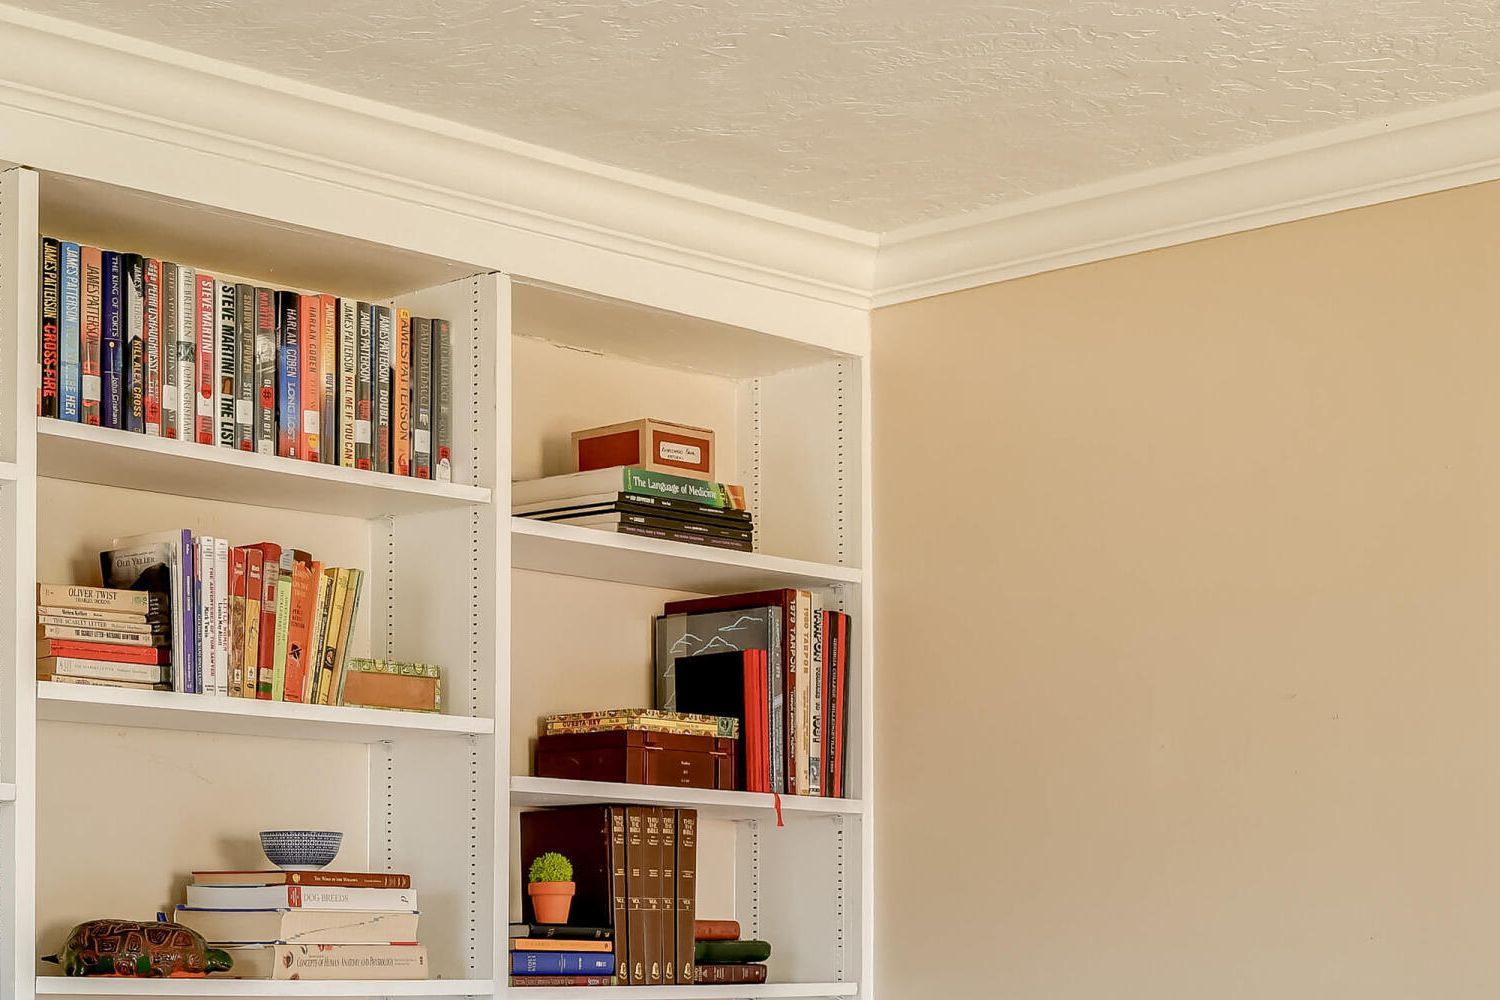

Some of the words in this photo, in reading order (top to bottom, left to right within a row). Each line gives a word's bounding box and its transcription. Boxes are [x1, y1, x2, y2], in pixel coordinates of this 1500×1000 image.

[44, 242, 58, 271] JAMES
[67, 247, 79, 275] JAMES
[86, 264, 100, 294] JAMES
[134, 264, 143, 288] JAMES
[43, 270, 58, 318] PATTERSON
[65, 276, 78, 323] PATTERSON
[112, 297, 119, 311] OF
[201, 281, 212, 311] STEVE
[222, 286, 235, 316] STEVE
[86, 294, 100, 347] PATTERSON
[286, 308, 297, 345] HARLAN
[309, 306, 317, 341] HARLAN
[344, 303, 353, 331] JAMES
[360, 311, 371, 335] JAMES
[379, 314, 390, 340] JAMES
[44, 325, 58, 366] CROSS
[201, 312, 212, 353] MARTINI
[133, 340, 142, 357] KILL
[221, 320, 234, 377] MARTINI
[309, 344, 317, 374] COBEN
[344, 330, 353, 374] PATTERSON
[359, 335, 370, 383] PATTERSON
[378, 339, 390, 383] PATTERSON
[133, 358, 142, 383] ALEX
[184, 366, 192, 388] JOHN
[287, 349, 297, 378] COBEN
[43, 369, 57, 397] FIRE
[287, 382, 296, 411] LONG
[344, 376, 353, 394] KILL
[65, 394, 76, 415] HER
[133, 386, 142, 417] CROSS
[184, 391, 192, 435] GRISHAM
[221, 397, 234, 420] THE
[345, 396, 353, 412] ME
[379, 388, 389, 427] DOUBLE
[400, 360, 408, 440] PATTERSON
[287, 412, 296, 443] LOST
[345, 412, 353, 421] IF
[221, 422, 234, 448] LIST
[344, 423, 353, 442] YOU
[344, 442, 353, 460] CAN
[633, 476, 647, 488] The
[647, 478, 680, 495] Language
[680, 483, 689, 494] of
[688, 484, 717, 499] Medicine
[68, 588, 93, 598] OLIVER
[96, 591, 118, 600] TWIST
[813, 608, 821, 662] TARPON
[321, 894, 348, 902] BREEDS
[296, 956, 317, 967] CONCEPTS
[323, 956, 340, 968] HUMAN
